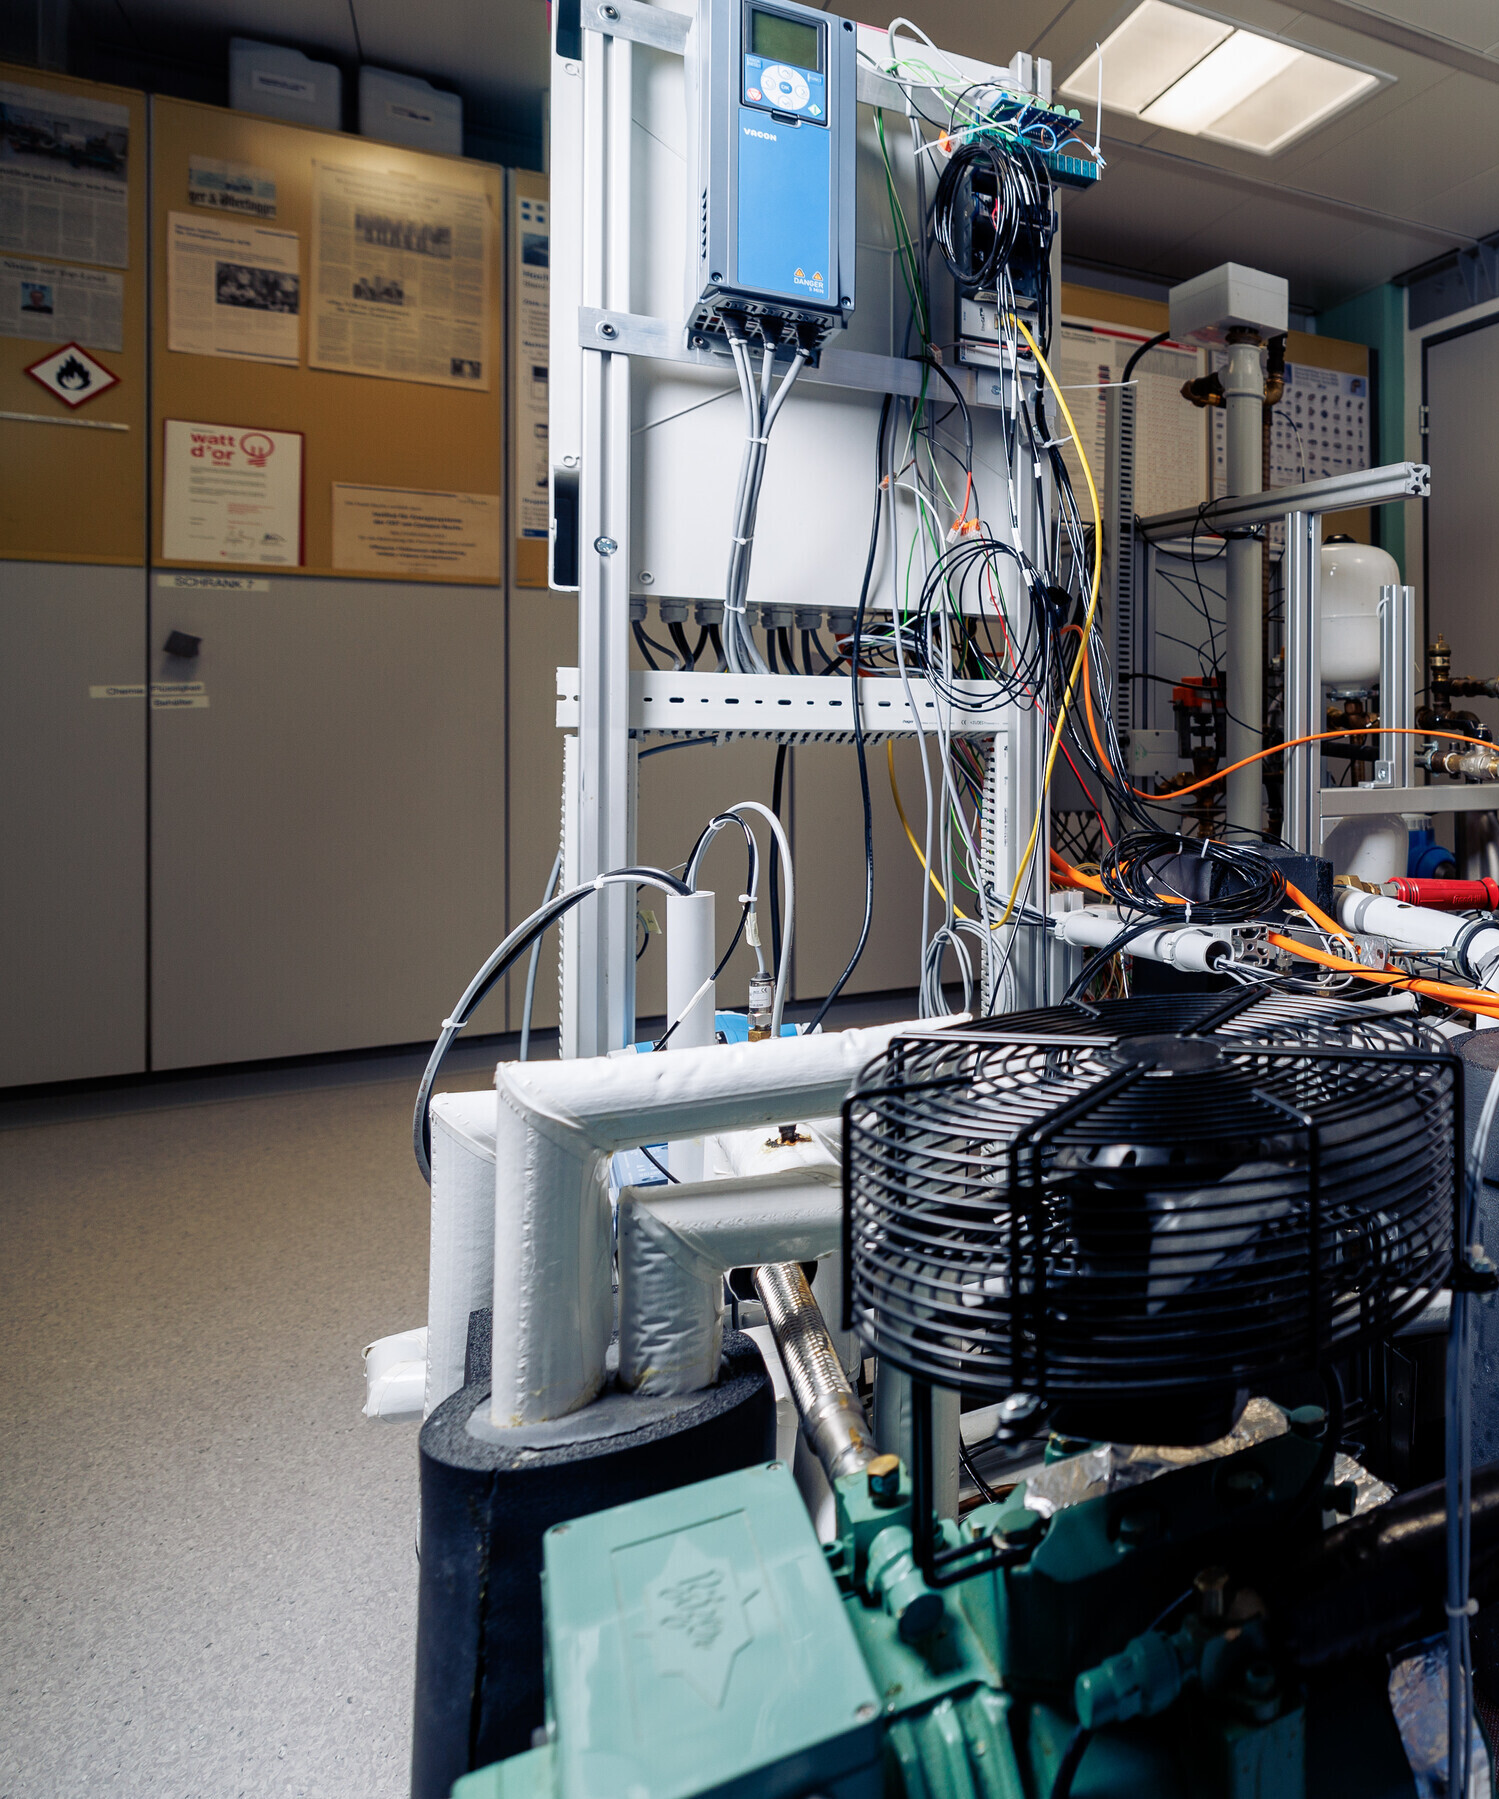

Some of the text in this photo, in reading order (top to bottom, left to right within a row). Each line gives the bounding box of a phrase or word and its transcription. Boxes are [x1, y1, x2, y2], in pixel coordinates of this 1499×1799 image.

[743, 127, 778, 142] VACON
[794, 277, 824, 289] DANGER
[190, 432, 235, 448] watt
[174, 576, 243, 589] SCHRANK
